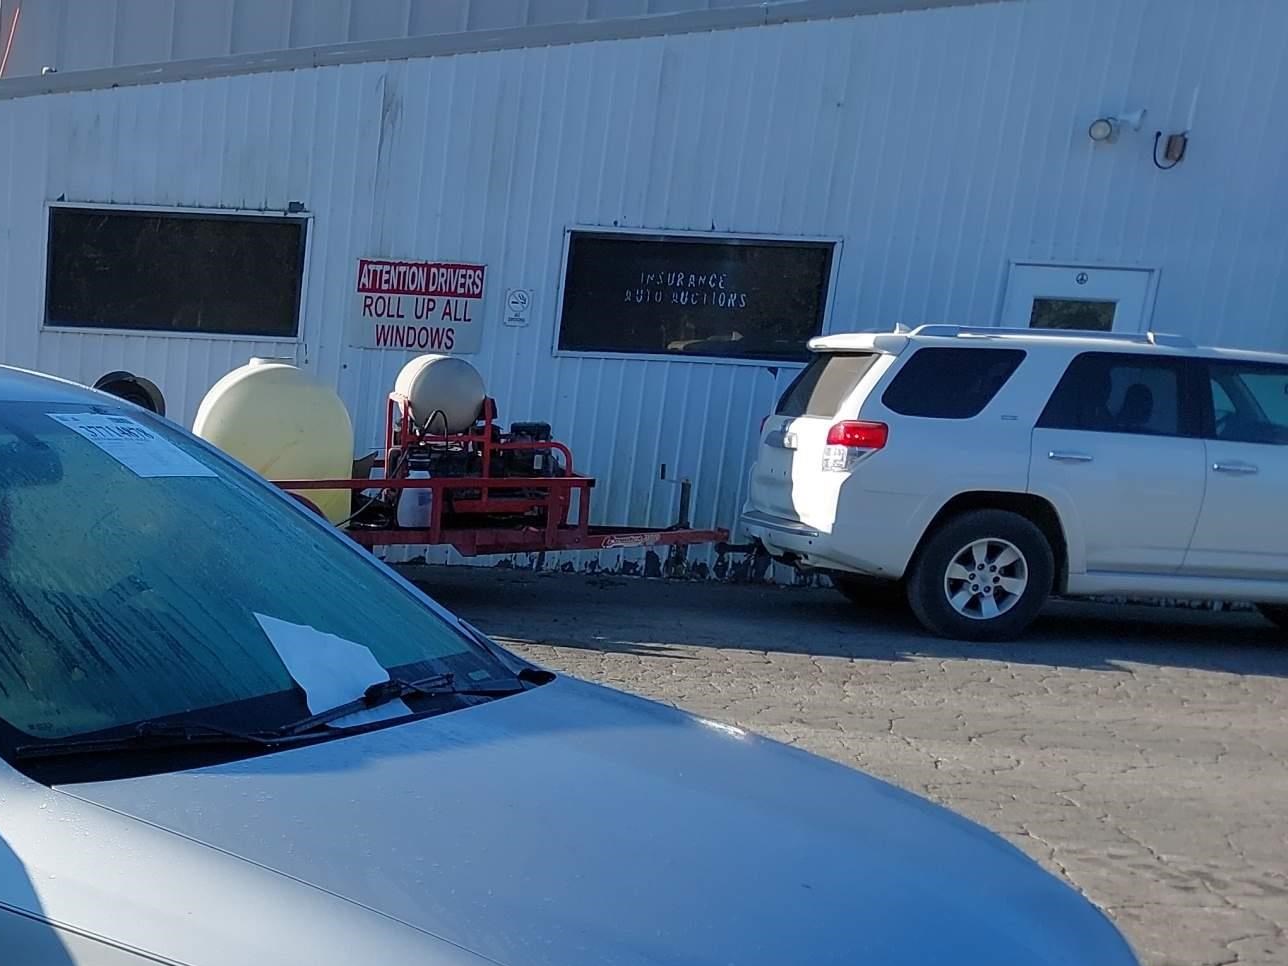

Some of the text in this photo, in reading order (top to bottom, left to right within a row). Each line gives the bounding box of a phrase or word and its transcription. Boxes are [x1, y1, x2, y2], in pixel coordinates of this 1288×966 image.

[360, 264, 483, 294] ATTENTION DRIVERS
[640, 271, 727, 289] INSURANCE
[362, 296, 472, 322] ROLL UP ALL
[624, 288, 746, 308] AUTO AUCTIONS
[375, 324, 455, 349] WINDOWS
